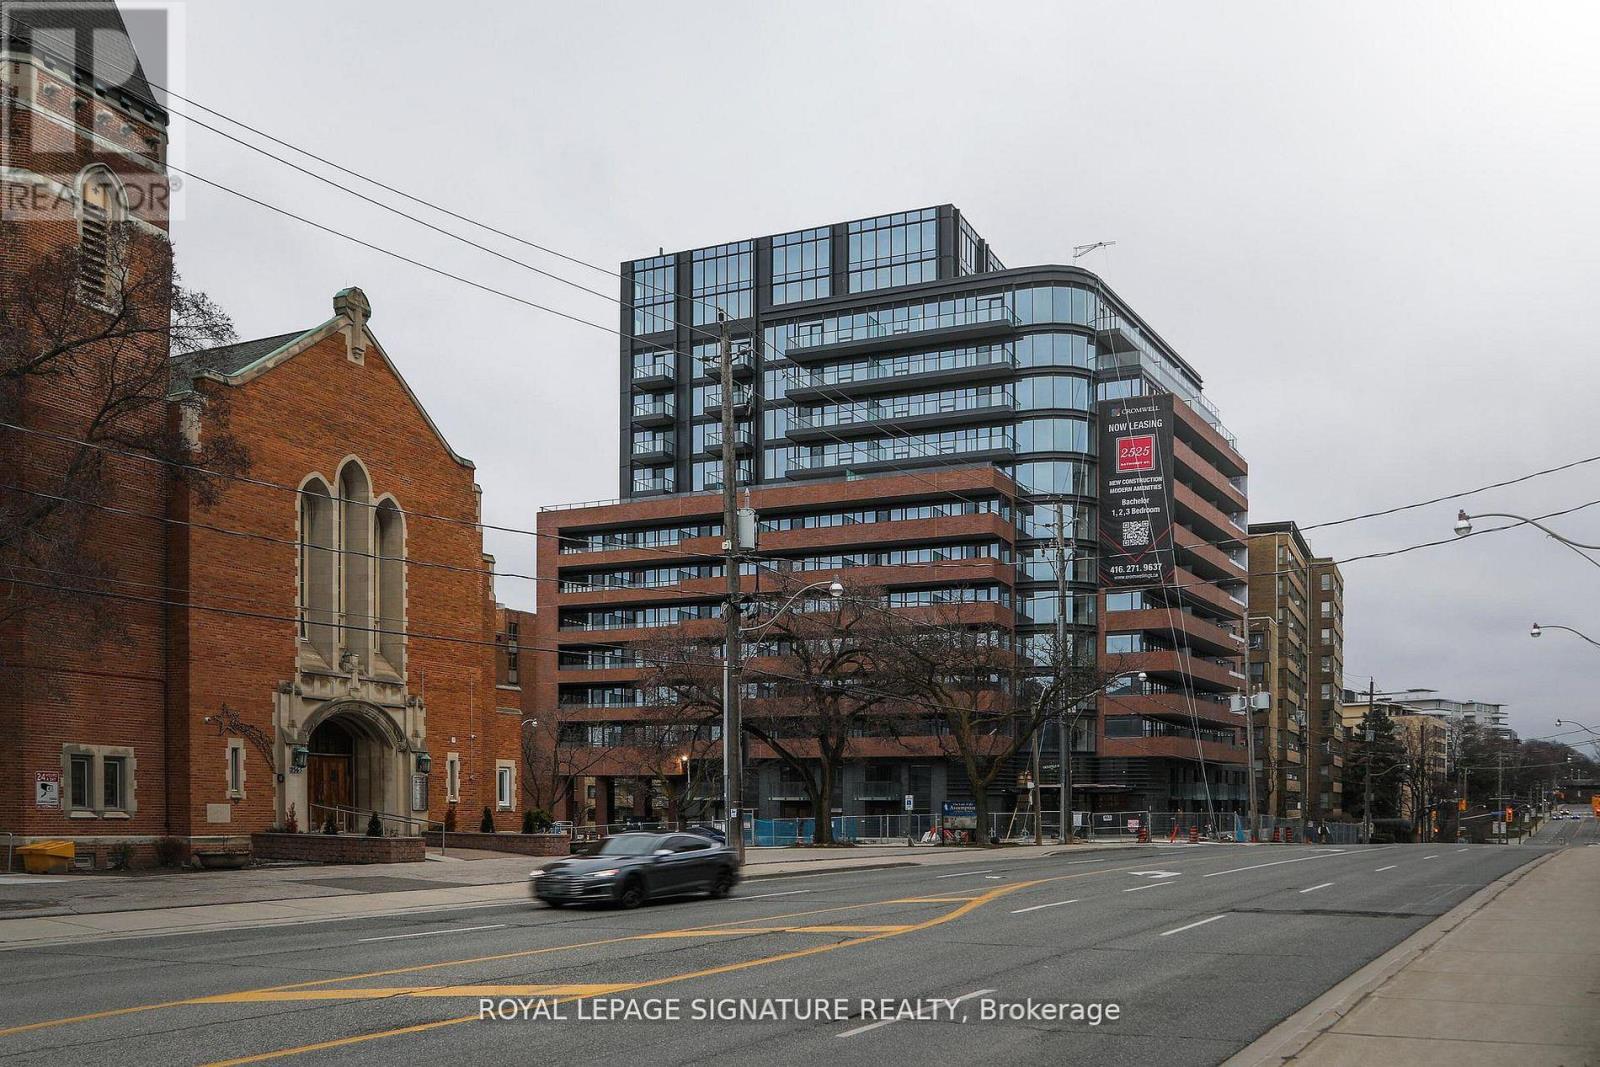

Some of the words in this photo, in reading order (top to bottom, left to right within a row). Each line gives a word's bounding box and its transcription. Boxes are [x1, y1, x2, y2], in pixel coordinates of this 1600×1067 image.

[1121, 405, 1160, 414] CROMWELL
[1108, 422, 1127, 432] NOW
[1129, 418, 1163, 430] LEASING
[1120, 446, 1150, 458] 2525
